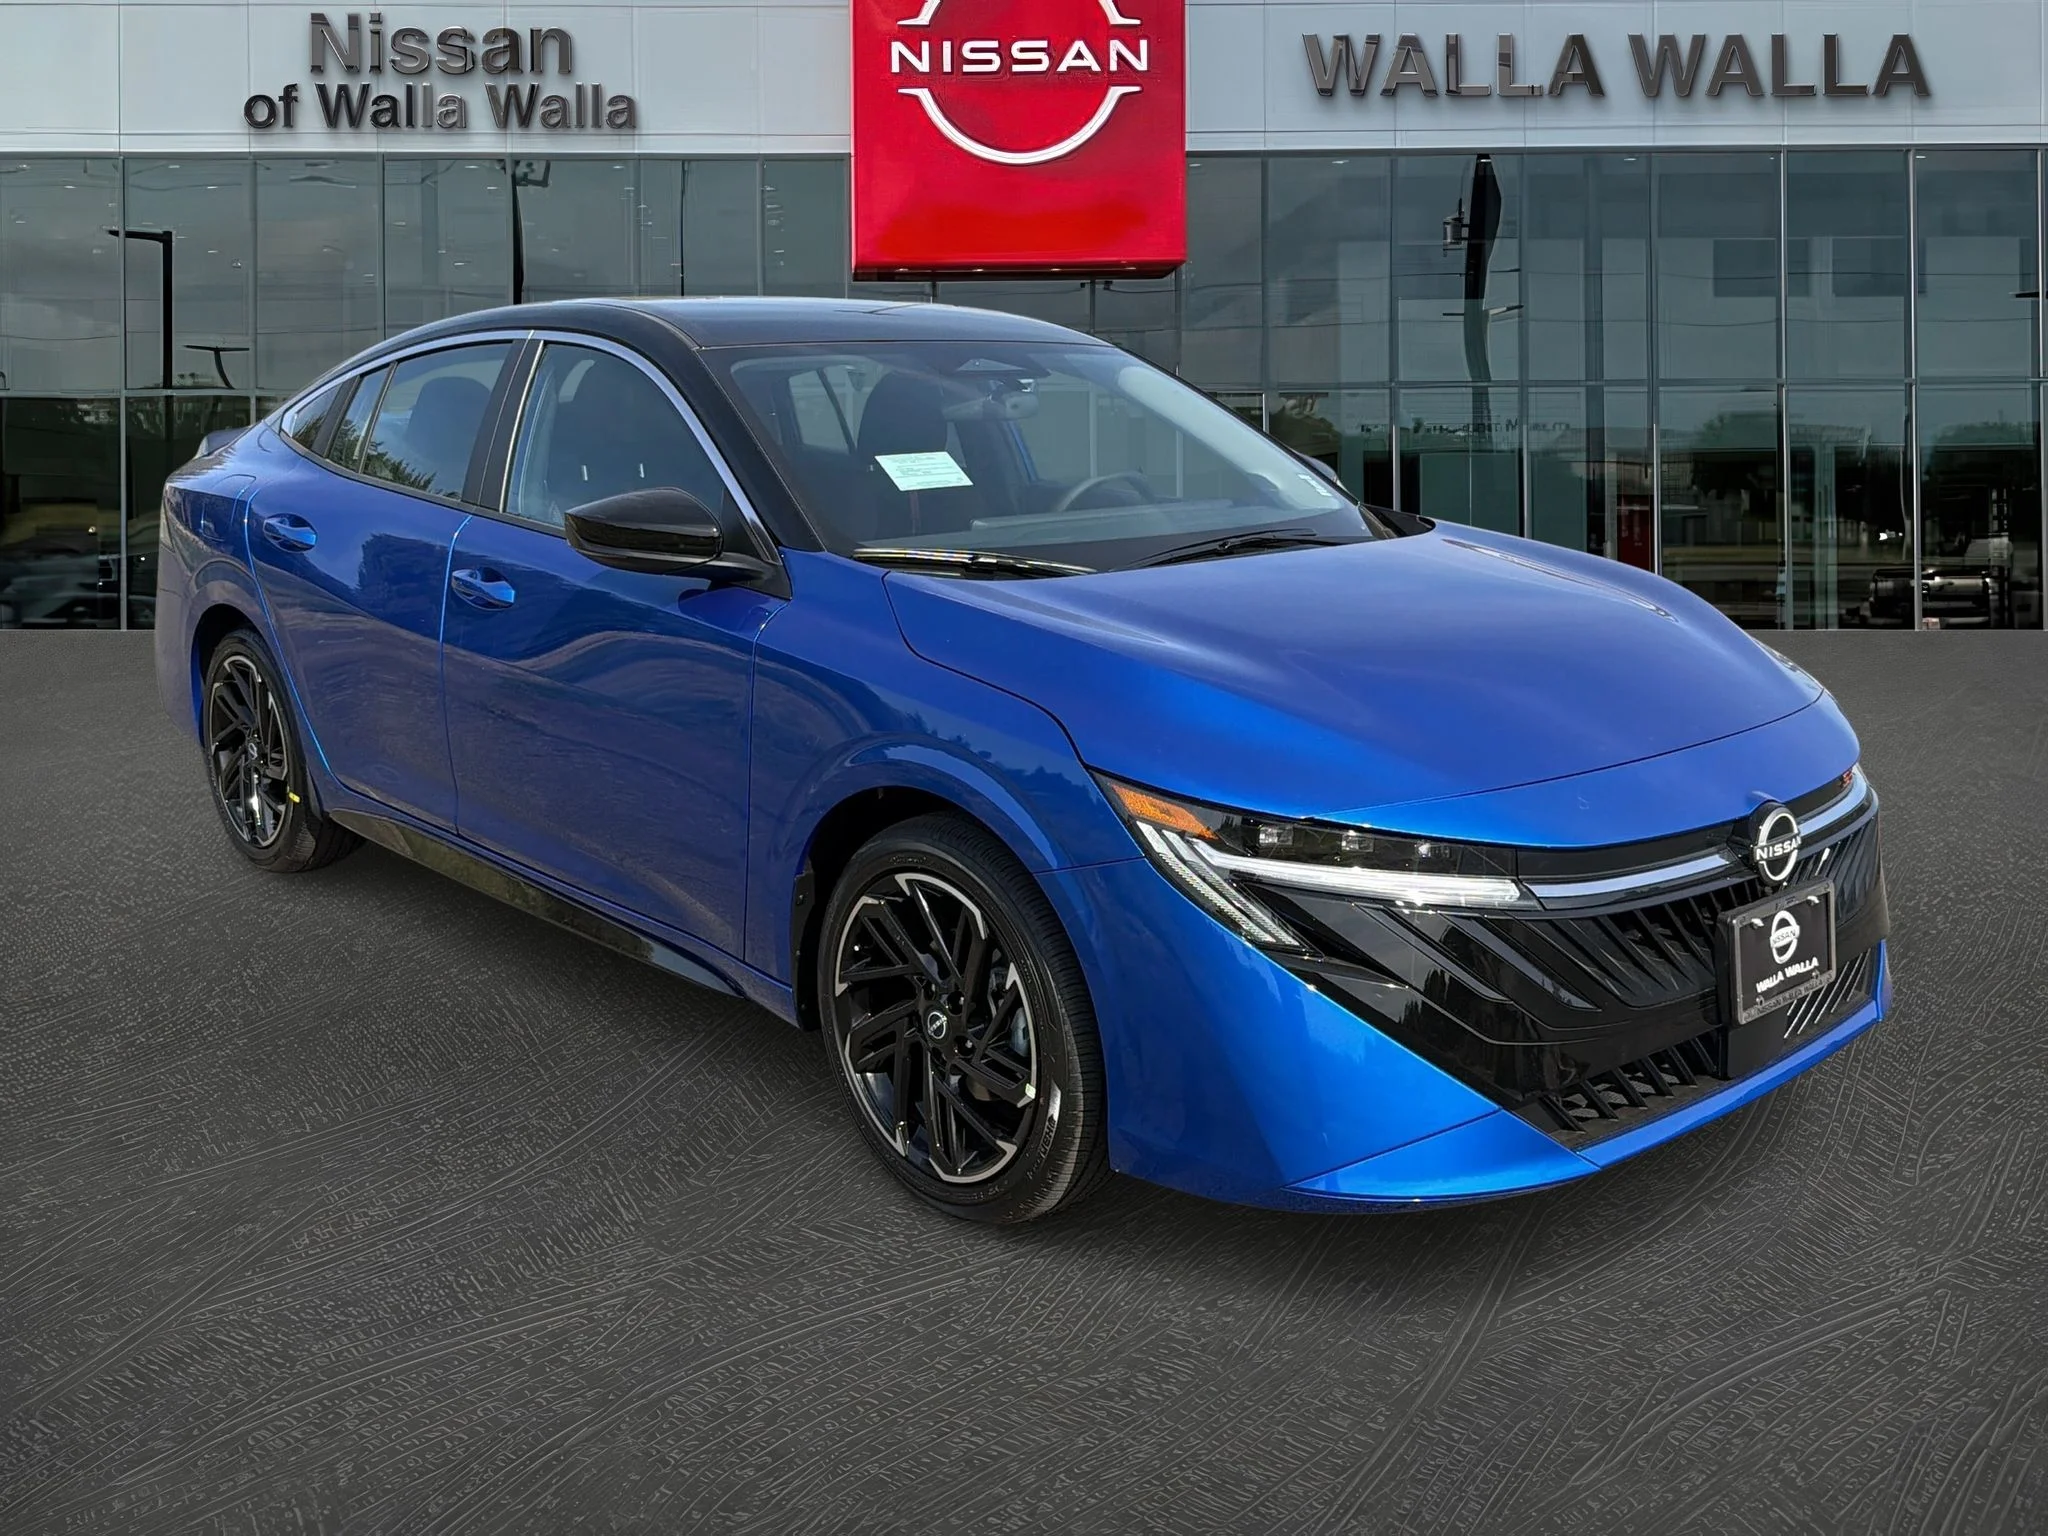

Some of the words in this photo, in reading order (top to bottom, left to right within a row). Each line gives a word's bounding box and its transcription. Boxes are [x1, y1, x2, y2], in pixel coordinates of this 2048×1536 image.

[310, 12, 572, 74] Nissan
[890, 39, 1149, 73] NISSAN
[1301, 32, 1605, 97] WALLA
[1628, 32, 1932, 97] WALLA
[243, 83, 299, 128] of
[314, 82, 469, 128] Walla
[484, 82, 637, 129] Walla
[1756, 835, 1802, 861] NISSAN
[1755, 970, 1784, 993] WALLA
[1784, 956, 1819, 978] WALLA
